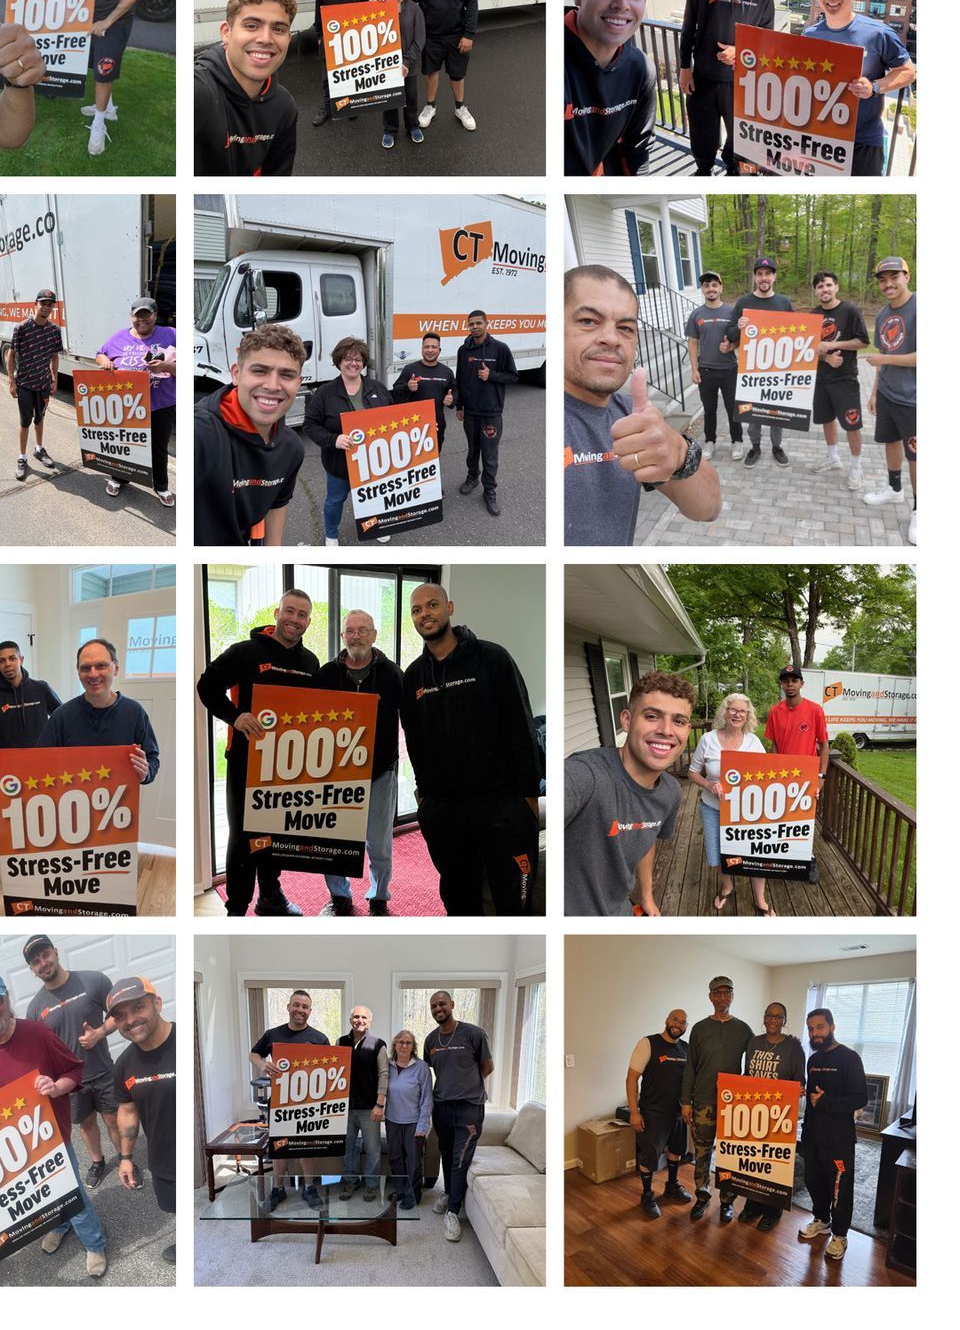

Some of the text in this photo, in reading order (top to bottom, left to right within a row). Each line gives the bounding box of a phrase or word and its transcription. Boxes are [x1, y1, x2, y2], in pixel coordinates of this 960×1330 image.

[329, 18, 398, 66] 100%
[332, 53, 400, 84] Stress-Free
[739, 70, 849, 127] 100%
[739, 121, 845, 165] Stress-Free
[453, 230, 483, 262] CT
[491, 267, 518, 277] EST. 1972
[418, 318, 538, 333] WHEN KEEPS YOU
[743, 335, 815, 370] 100%
[741, 374, 812, 388] Stress-Free
[78, 393, 145, 425] 100%
[82, 427, 146, 444] Stress-Free
[351, 422, 435, 483] 100%
[357, 463, 437, 503] Stress-Free
[824, 685, 839, 697] CT
[255, 726, 368, 782] 100%
[252, 786, 366, 810] Stress-Free
[725, 781, 814, 823] 100%
[1, 784, 132, 850] 100%
[726, 824, 811, 841] Stress-Free
[272, 841, 361, 856] MovingandStorage.com
[7, 850, 132, 878] Stress-Free
[43, 877, 101, 896] Move
[748, 1059, 778, 1072] SHIRT
[750, 1050, 773, 1060] THIS
[275, 1065, 347, 1105] 100%
[275, 1101, 346, 1123] Stress-Free
[720, 1103, 793, 1139] 100%
[719, 1140, 791, 1161] Stress-Free
